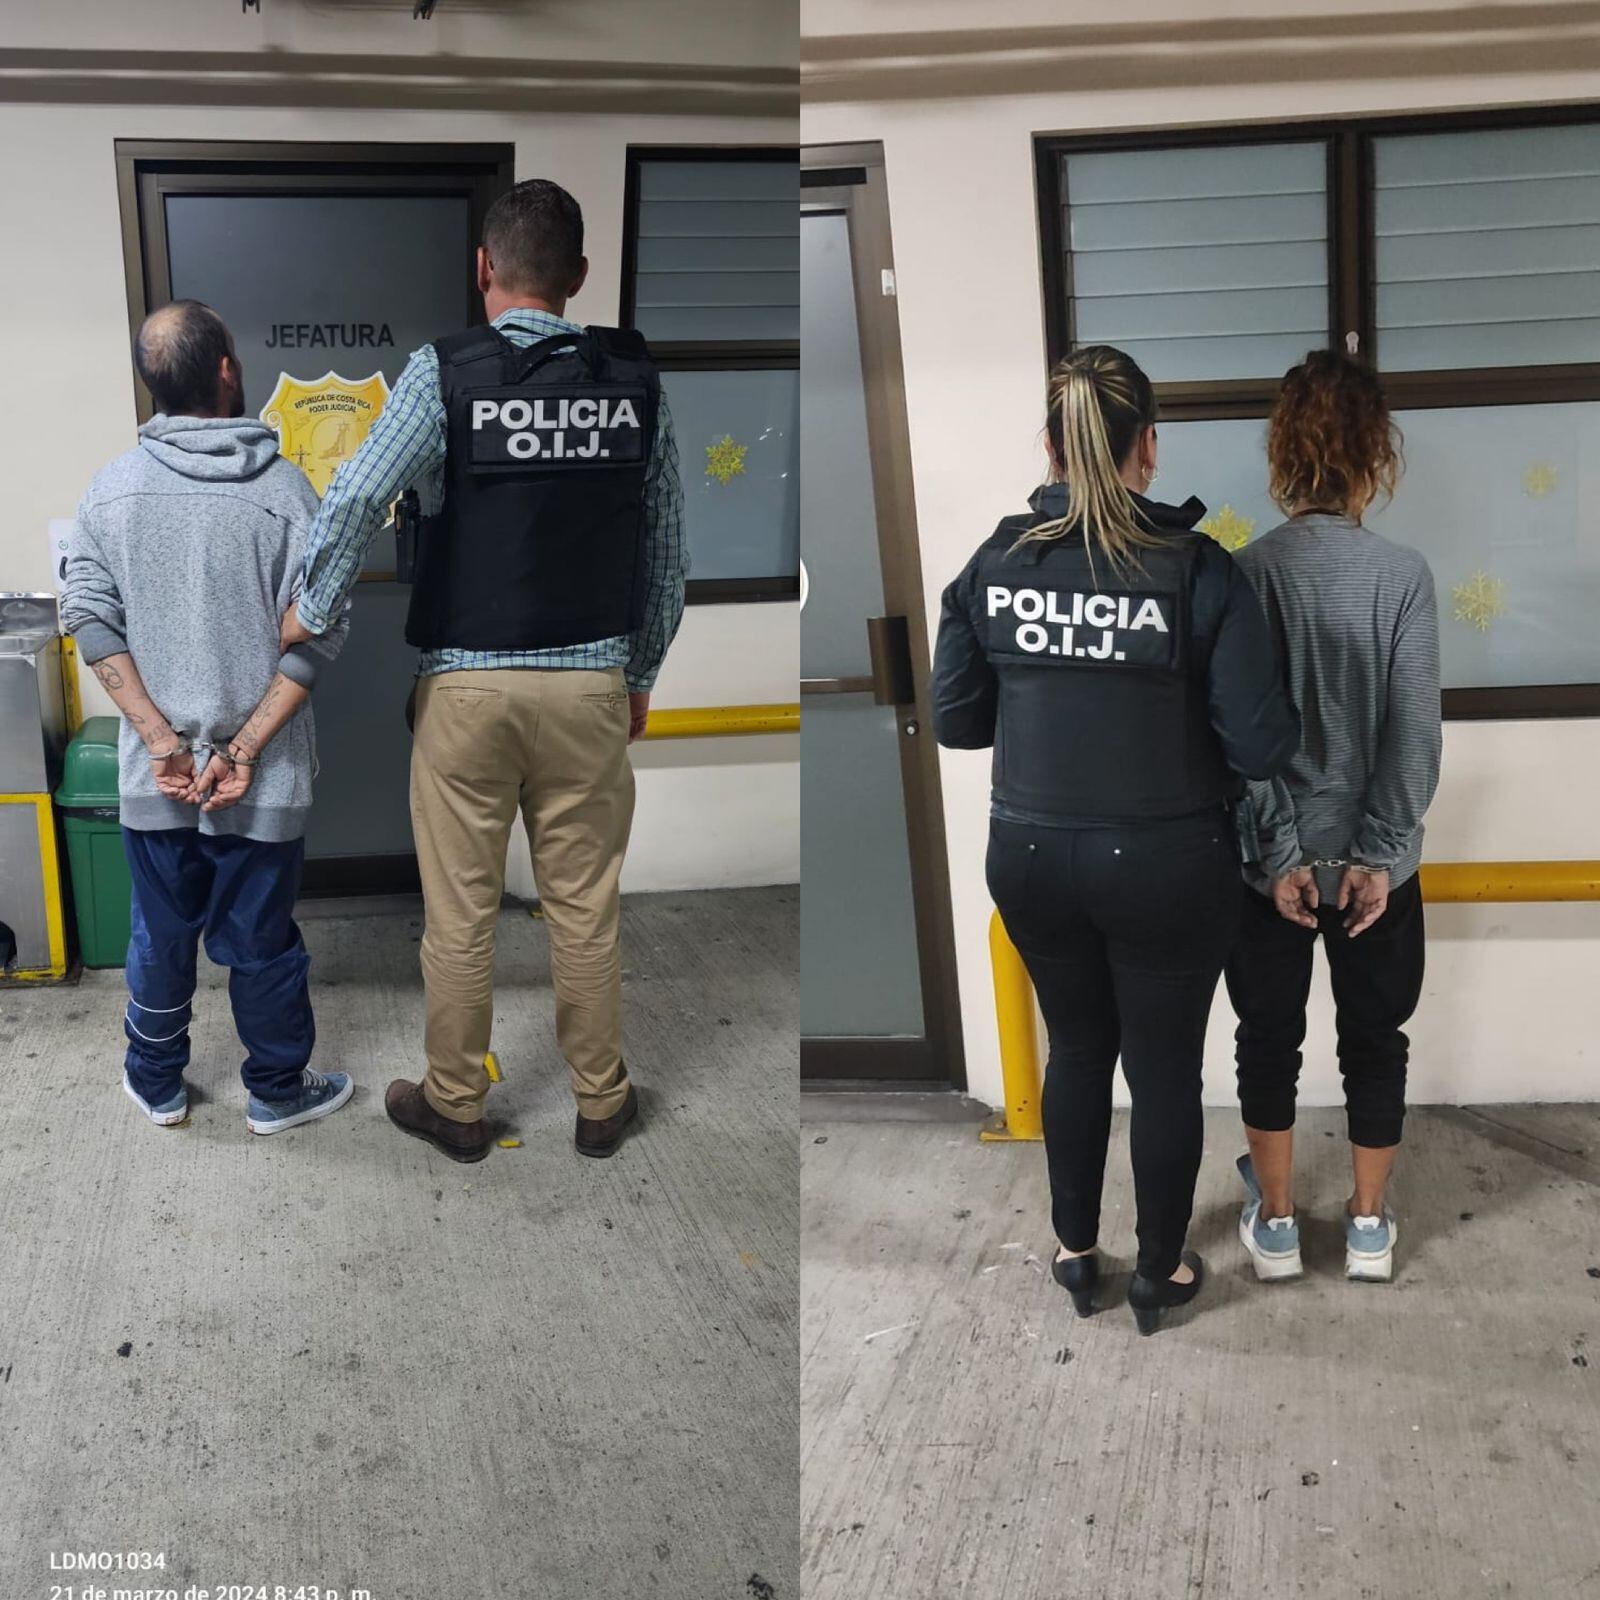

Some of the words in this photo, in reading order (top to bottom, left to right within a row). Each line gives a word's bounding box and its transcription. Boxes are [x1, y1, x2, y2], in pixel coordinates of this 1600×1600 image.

[265, 323, 395, 348] JEFATURA
[309, 404, 328, 413] PODER
[330, 403, 356, 412] JUDICIAL
[336, 395, 355, 403] COSTA
[357, 399, 370, 410] RICA
[472, 399, 641, 430] POLICIA
[506, 431, 610, 459] O.I.J.
[986, 586, 1169, 632] POLICIA
[1015, 623, 1126, 661] O.I.J.
